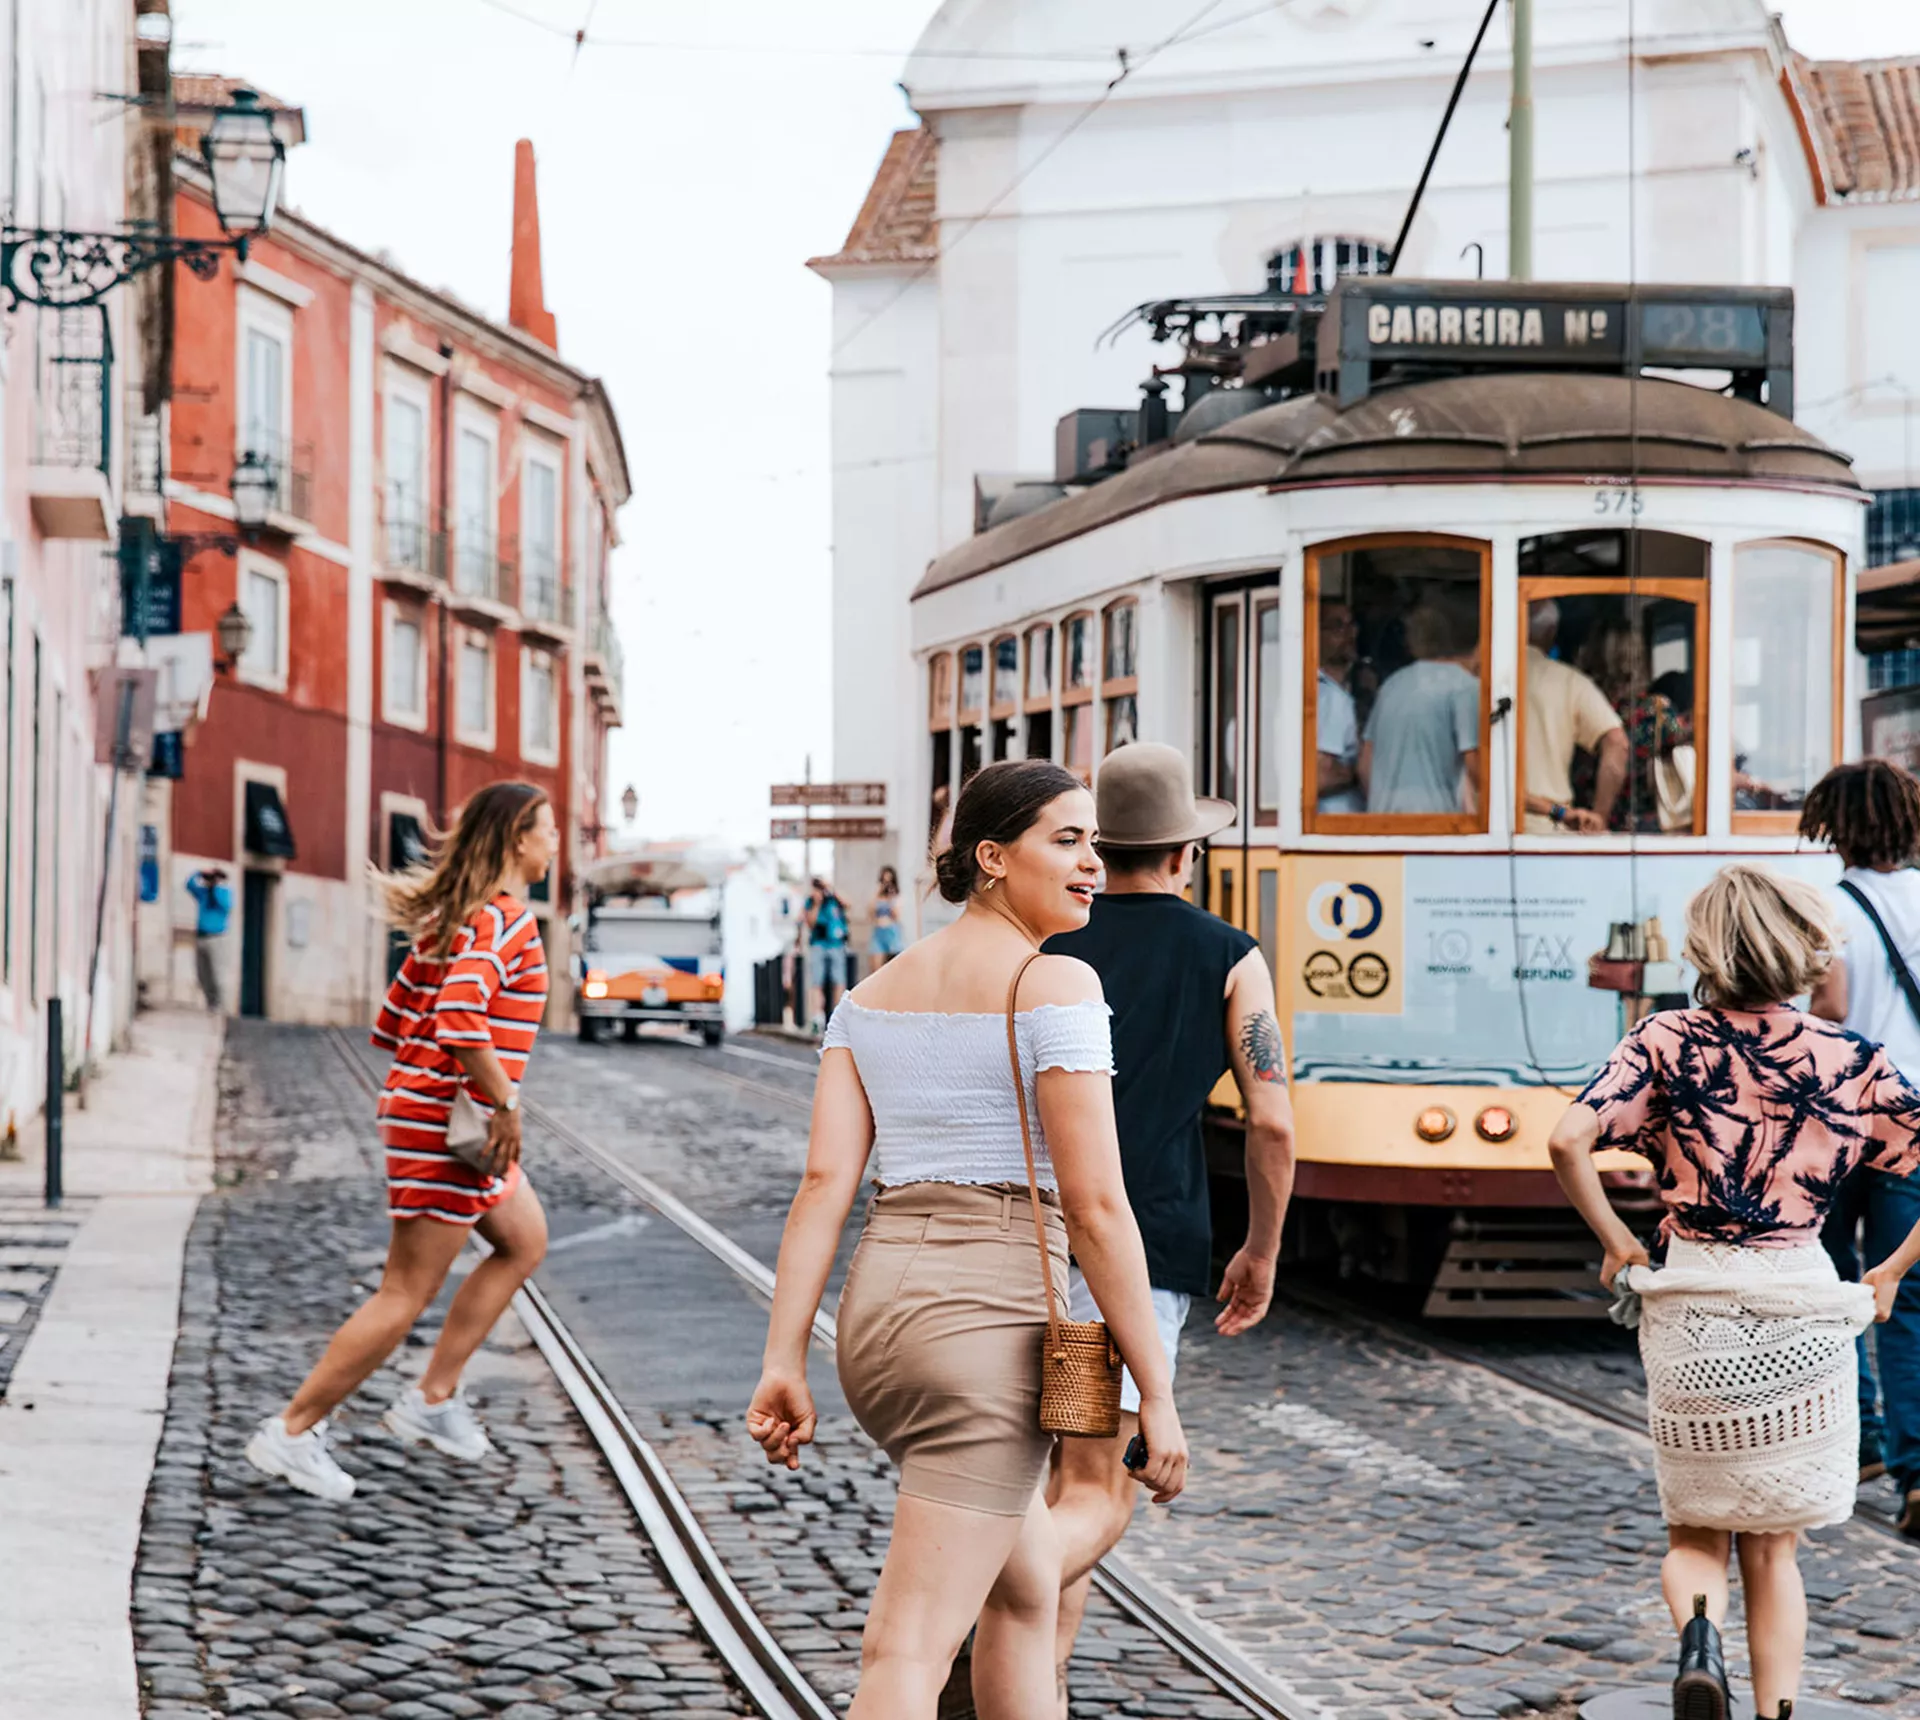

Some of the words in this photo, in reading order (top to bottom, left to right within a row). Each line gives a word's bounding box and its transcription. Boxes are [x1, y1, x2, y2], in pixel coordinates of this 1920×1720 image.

[1368, 304, 1544, 346] CARREIRA
[1661, 305, 1737, 350] 28
[1594, 490, 1645, 515] 575
[1515, 933, 1575, 968] TAX
